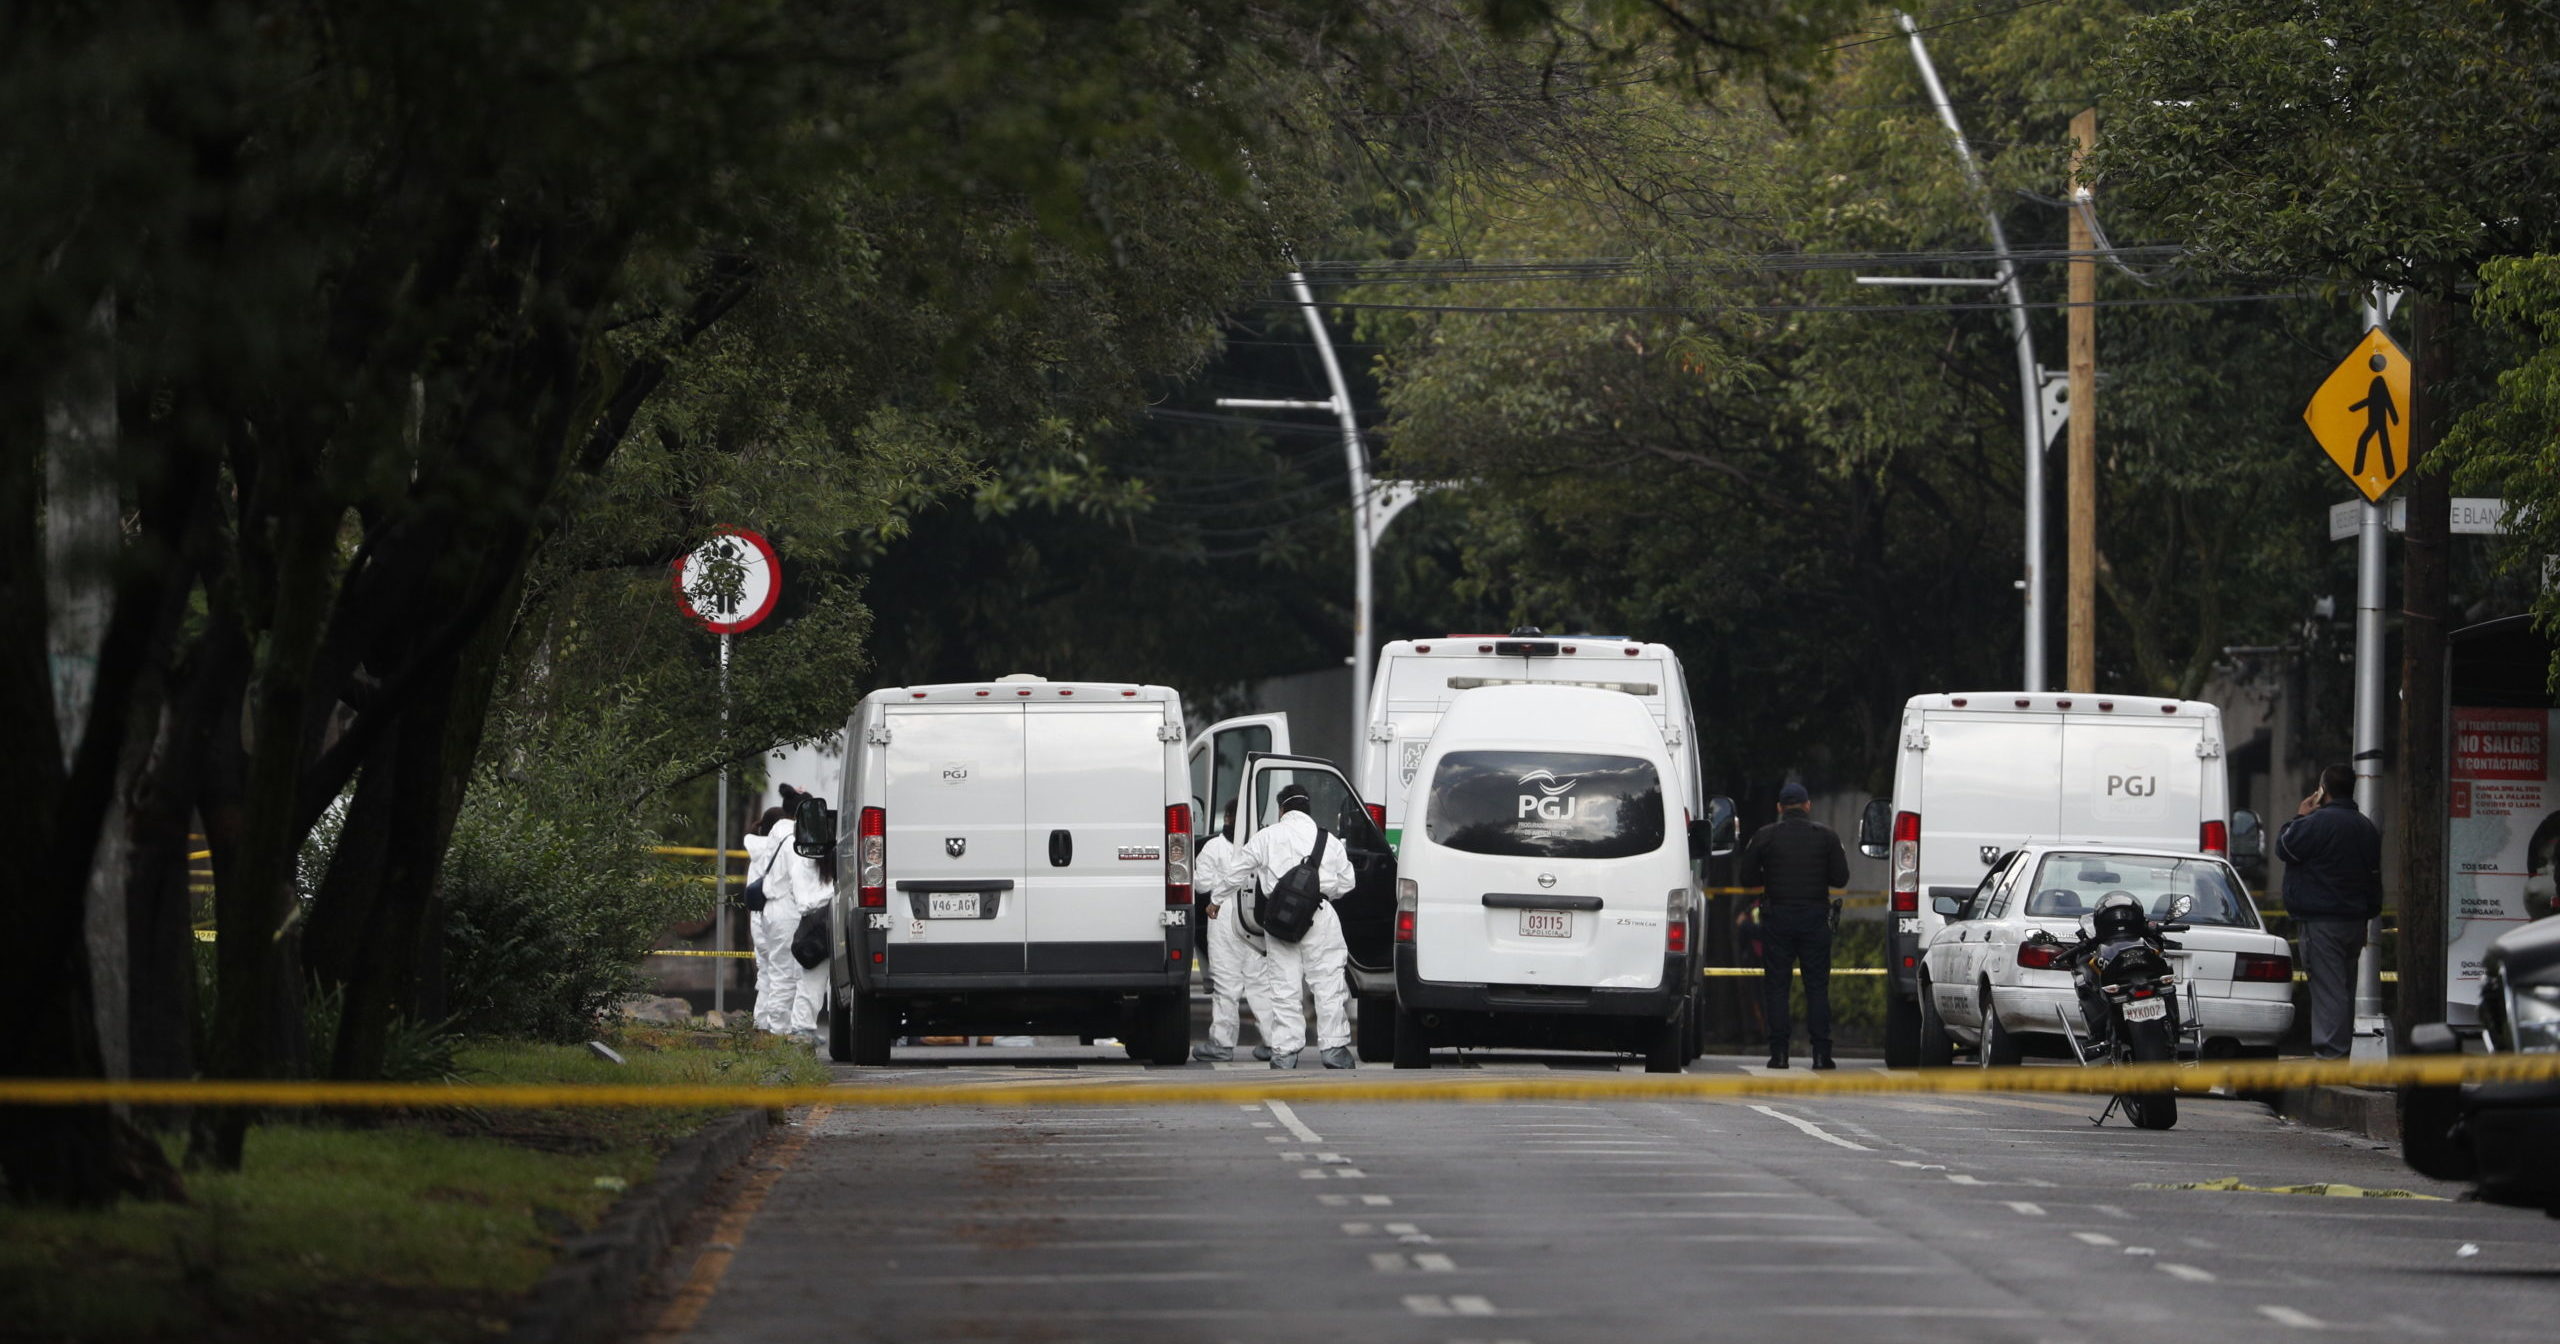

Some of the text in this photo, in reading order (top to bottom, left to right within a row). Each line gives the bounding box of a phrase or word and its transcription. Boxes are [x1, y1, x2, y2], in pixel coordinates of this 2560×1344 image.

[2458, 735, 2541, 754] NO SALGAS
[2457, 756, 2539, 771] Y CONTÁCTANOS
[943, 770, 967, 779] PGJ
[2107, 775, 2156, 797] PGJ
[1518, 795, 1576, 820] PGJ
[2461, 863, 2499, 871] TOS SECA
[2461, 898, 2489, 906] DOLOR
[1528, 915, 1563, 931] 03115
